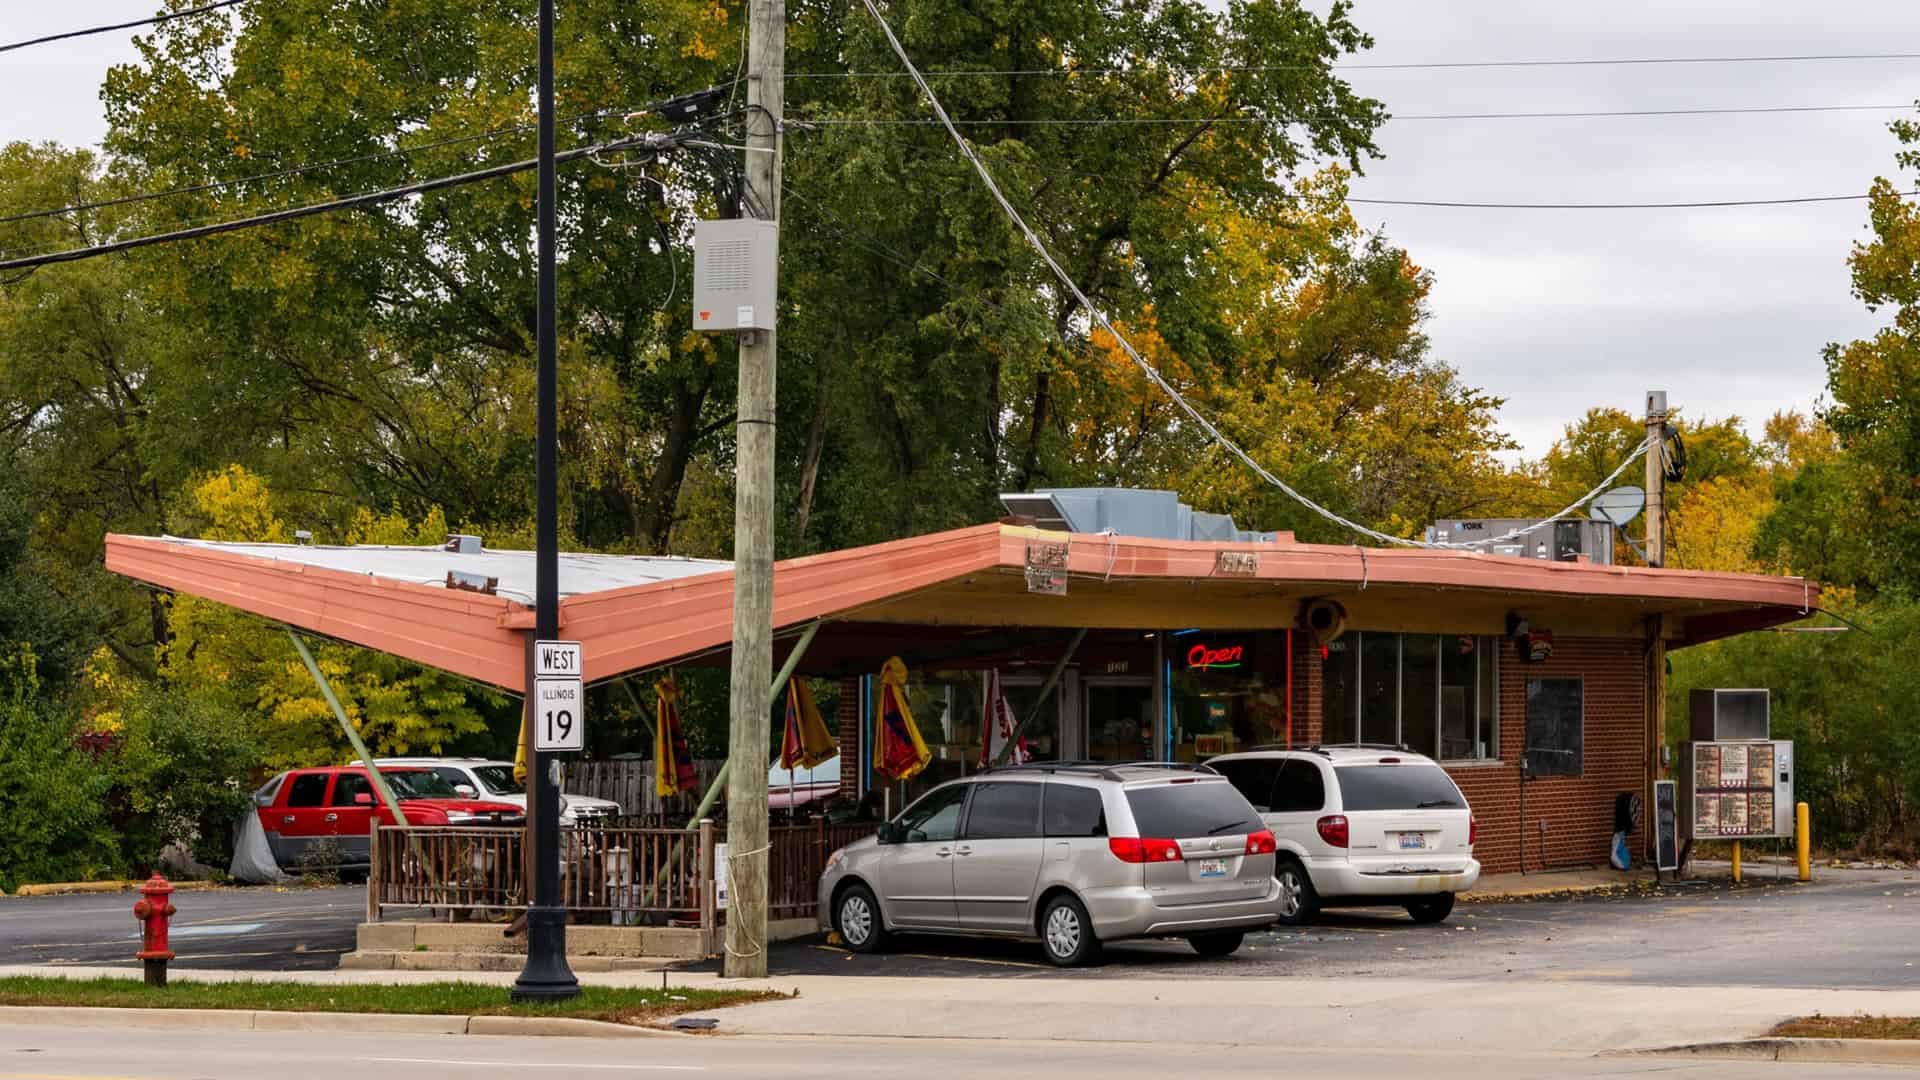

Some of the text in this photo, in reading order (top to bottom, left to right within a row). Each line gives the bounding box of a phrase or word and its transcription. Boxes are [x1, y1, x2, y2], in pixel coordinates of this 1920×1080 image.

[543, 648, 575, 669] WEST
[1188, 645, 1243, 672] Open
[543, 689, 575, 700] ILLINOIS
[546, 710, 572, 741] 19
